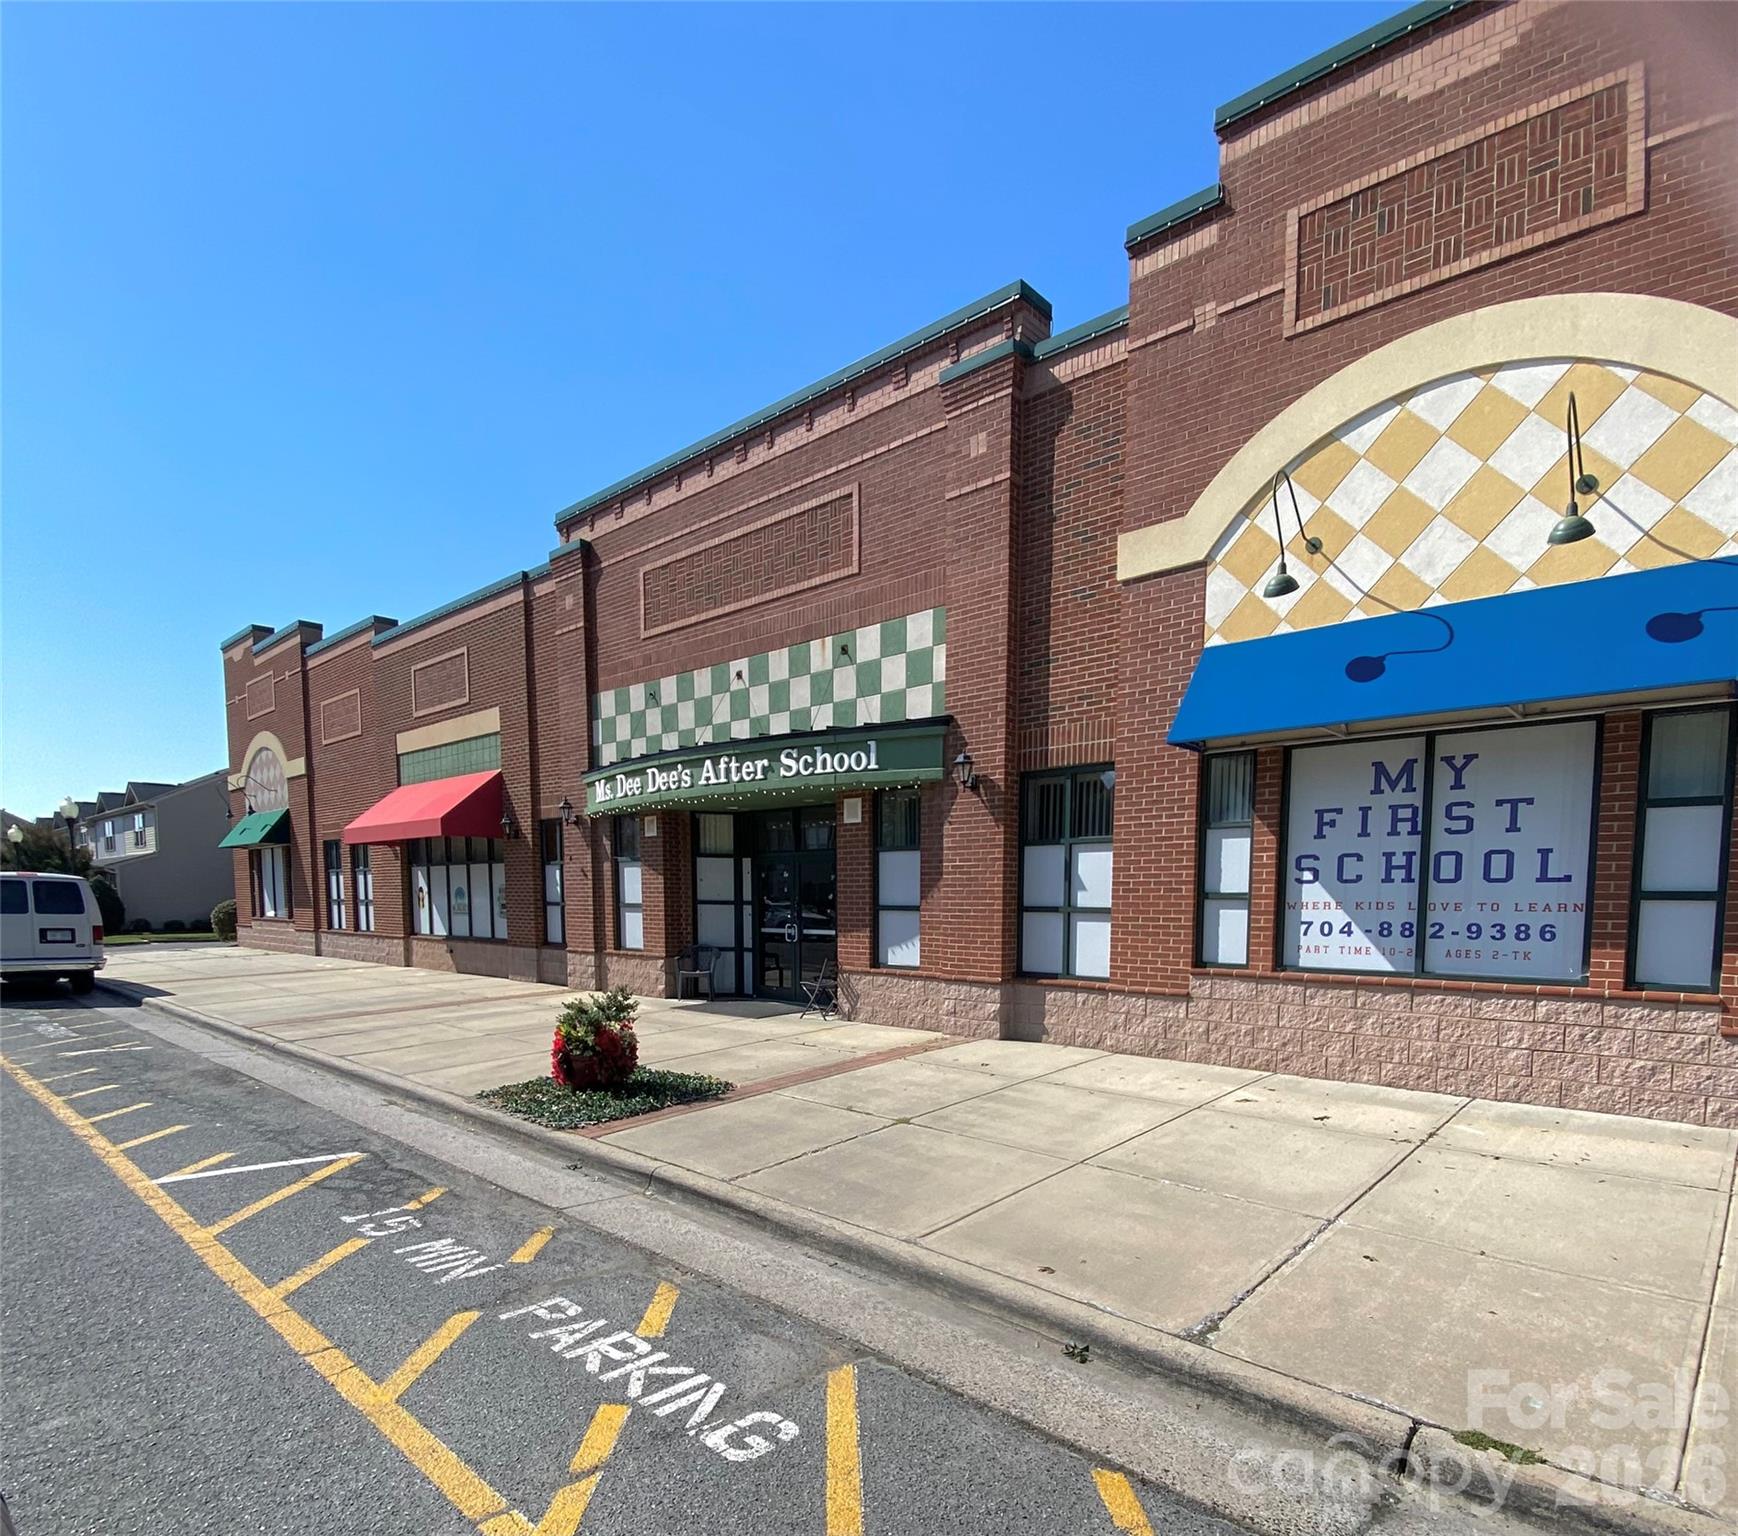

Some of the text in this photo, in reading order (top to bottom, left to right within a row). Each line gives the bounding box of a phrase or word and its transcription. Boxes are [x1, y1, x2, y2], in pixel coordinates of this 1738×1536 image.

[594, 740, 879, 803] Ms. Dee Dee's After School
[1370, 753, 1479, 795] MY
[1313, 797, 1535, 839] FIRST
[1294, 848, 1572, 884] SCHOOL
[1287, 901, 1585, 913] WHERE KIDS LOVE TO LEARN
[1300, 920, 1557, 942] 704-882-9386
[1297, 945, 1532, 960] PART TIME 10-2 AGES 2-TK
[339, 1206, 800, 1462] 15 MIN PARKING
